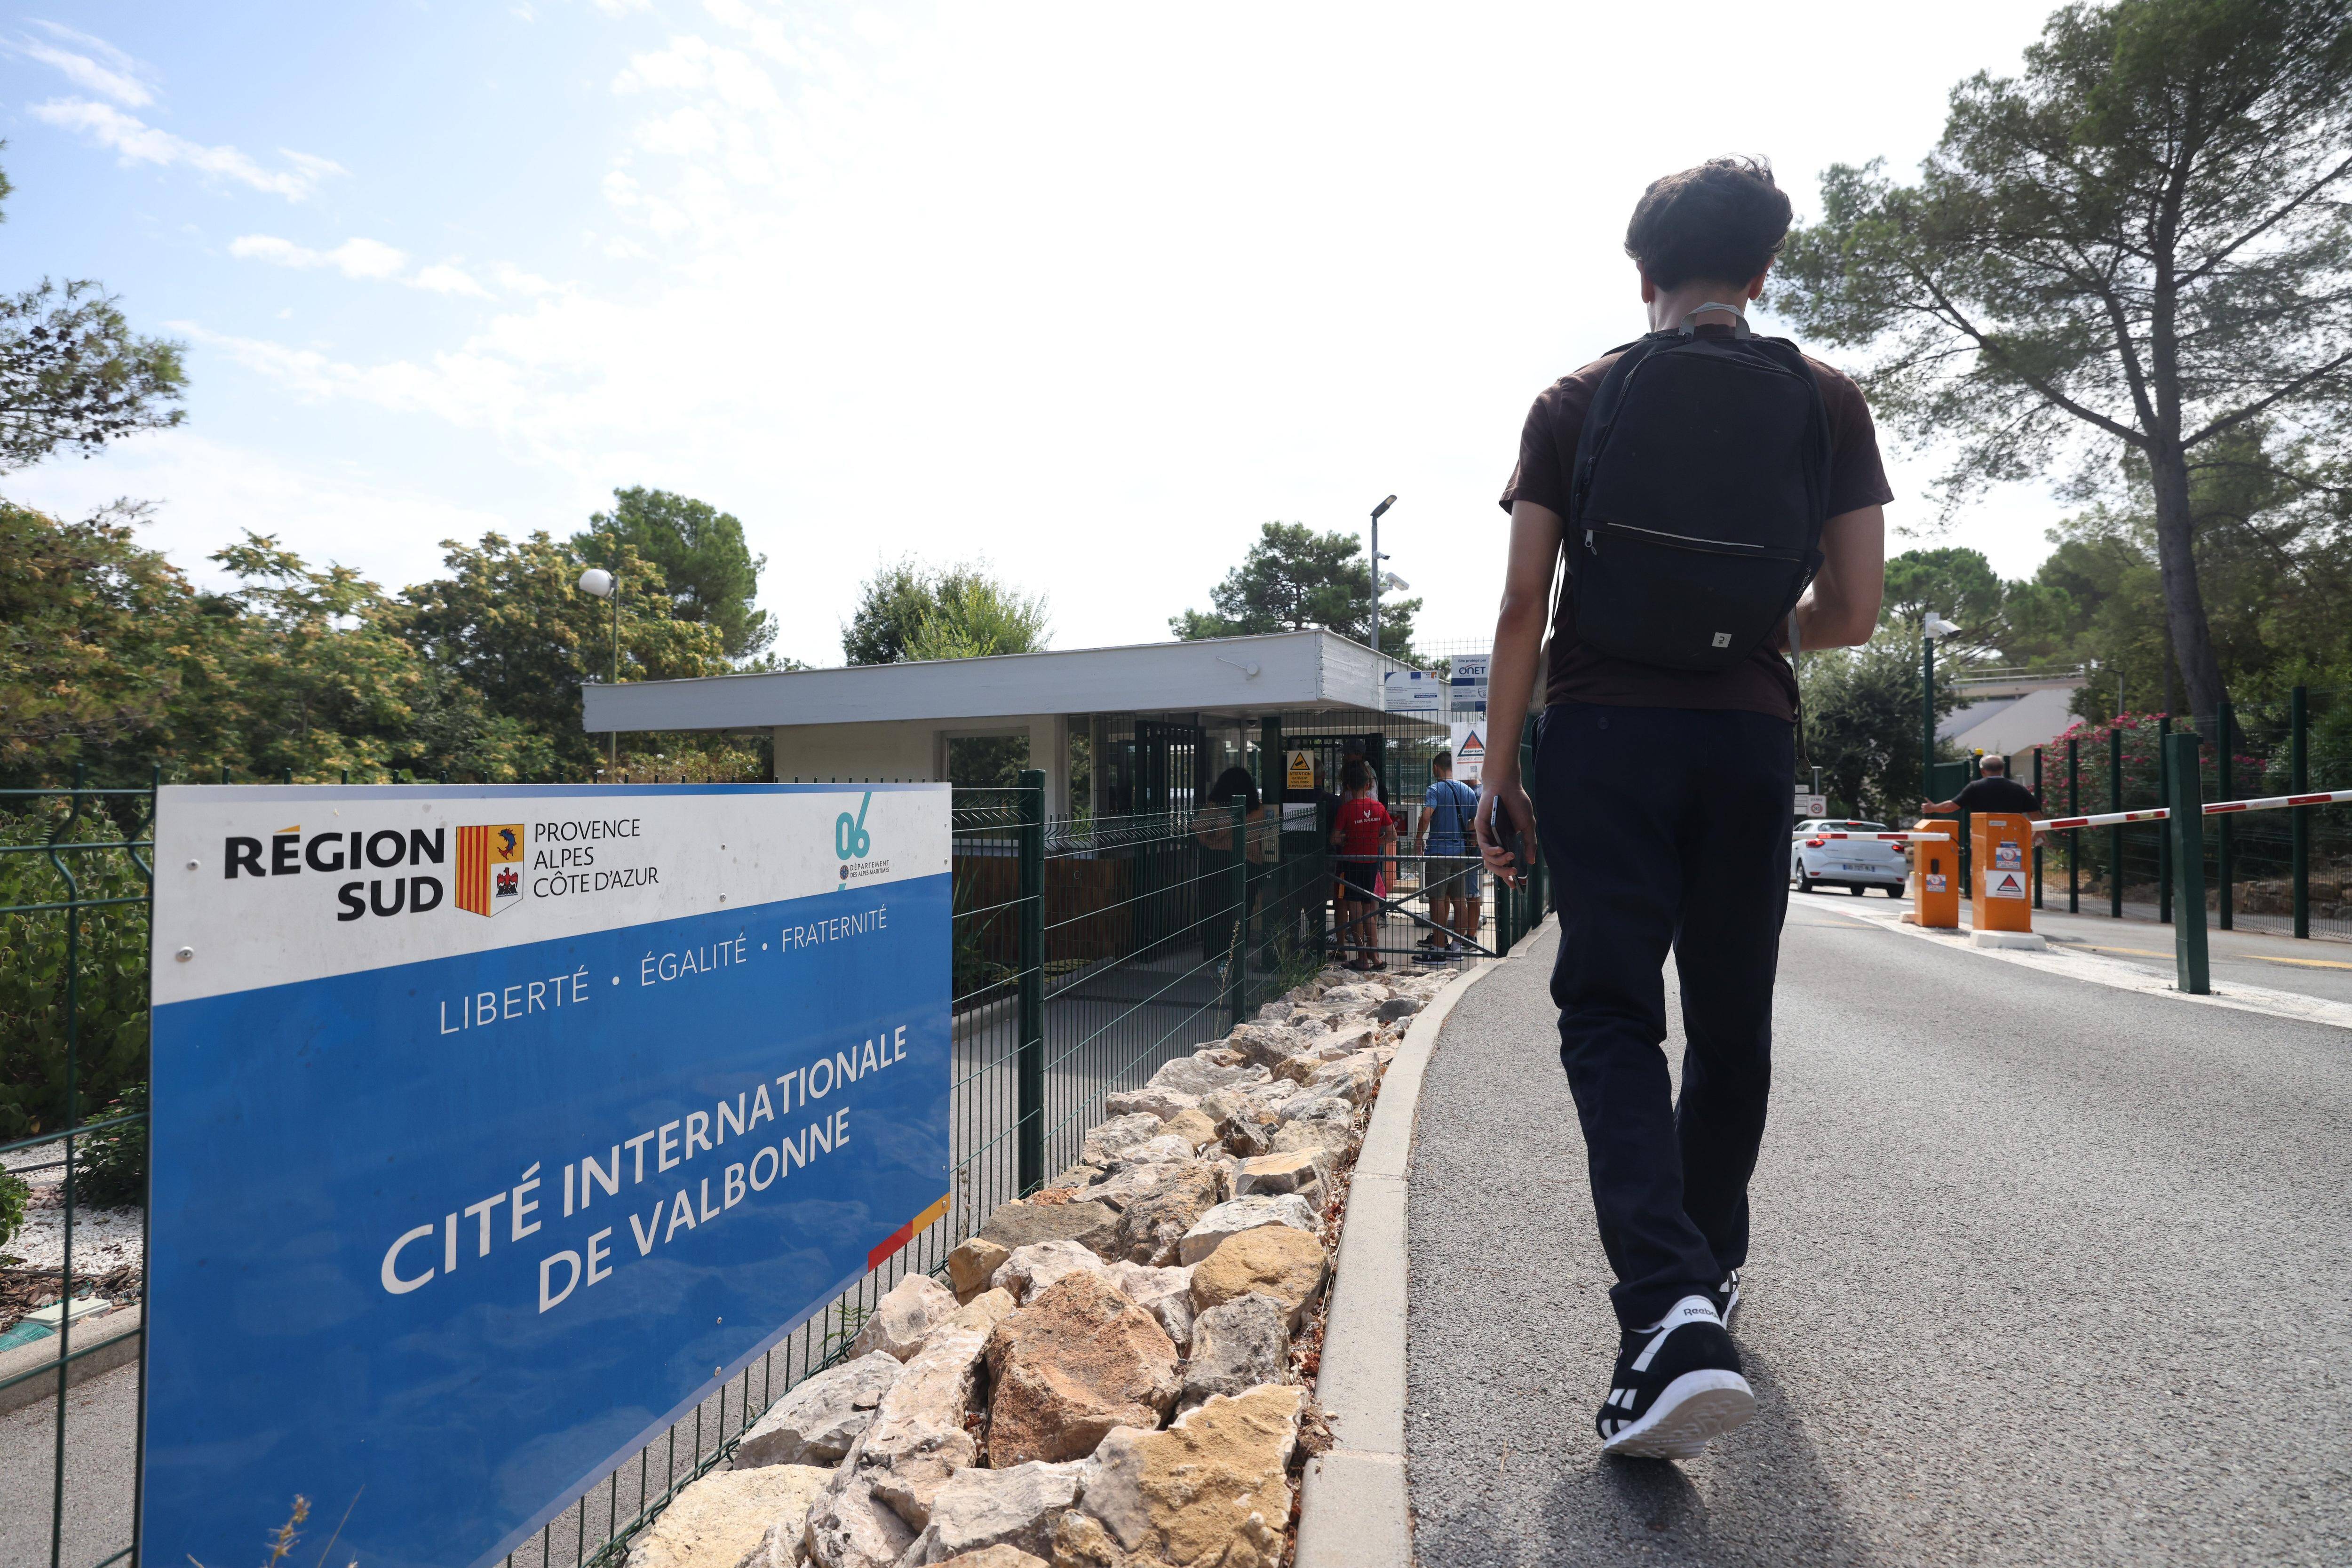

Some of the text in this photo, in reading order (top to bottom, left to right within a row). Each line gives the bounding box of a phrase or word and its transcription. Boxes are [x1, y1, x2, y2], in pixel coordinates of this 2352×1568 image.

[535, 819, 640, 843] PROVENCE
[836, 792, 872, 860] 06
[225, 825, 445, 879] RÉGION
[533, 847, 594, 870] ALPES
[850, 860, 889, 871] DÉPARTEMENT
[533, 867, 659, 898] CÔTE D'AZUR
[858, 867, 889, 876] ALPES-MARITIMES
[337, 876, 443, 921] SUD
[441, 904, 887, 1035] LIBERTÉ ÉGALITÉ FRATERNITÉ
[381, 1025, 907, 1295] CITÉ INTERNATIONALE
[539, 1106, 850, 1313] DE VALBONNE
[1684, 1308, 1718, 1319] Reebo
